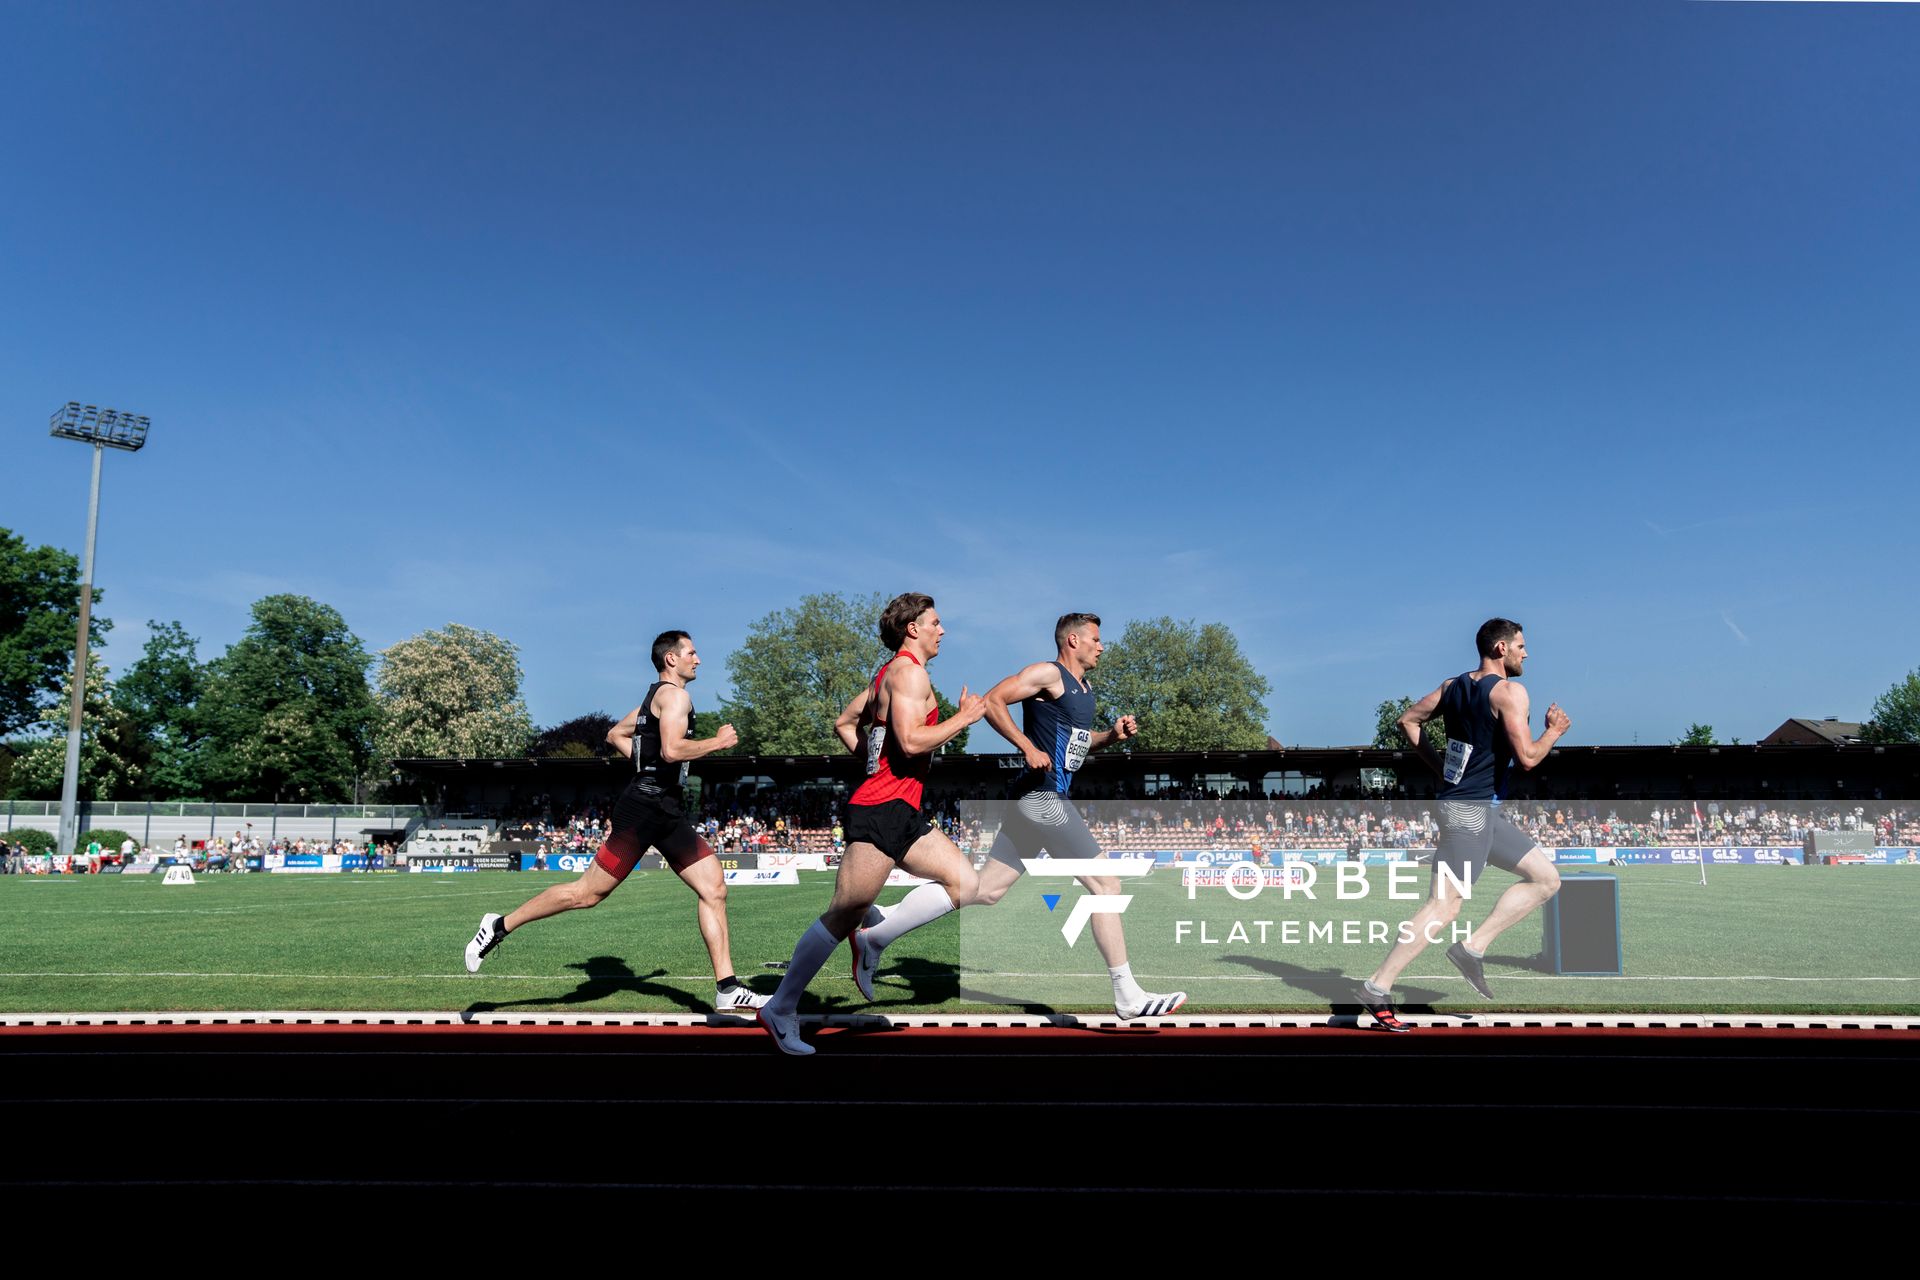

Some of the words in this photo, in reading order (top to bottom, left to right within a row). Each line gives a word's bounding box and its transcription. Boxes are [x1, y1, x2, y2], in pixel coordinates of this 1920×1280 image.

[1451, 741, 1464, 753] GLS
[1215, 852, 1243, 861] PLAN
[416, 859, 469, 867] NOVAFON
